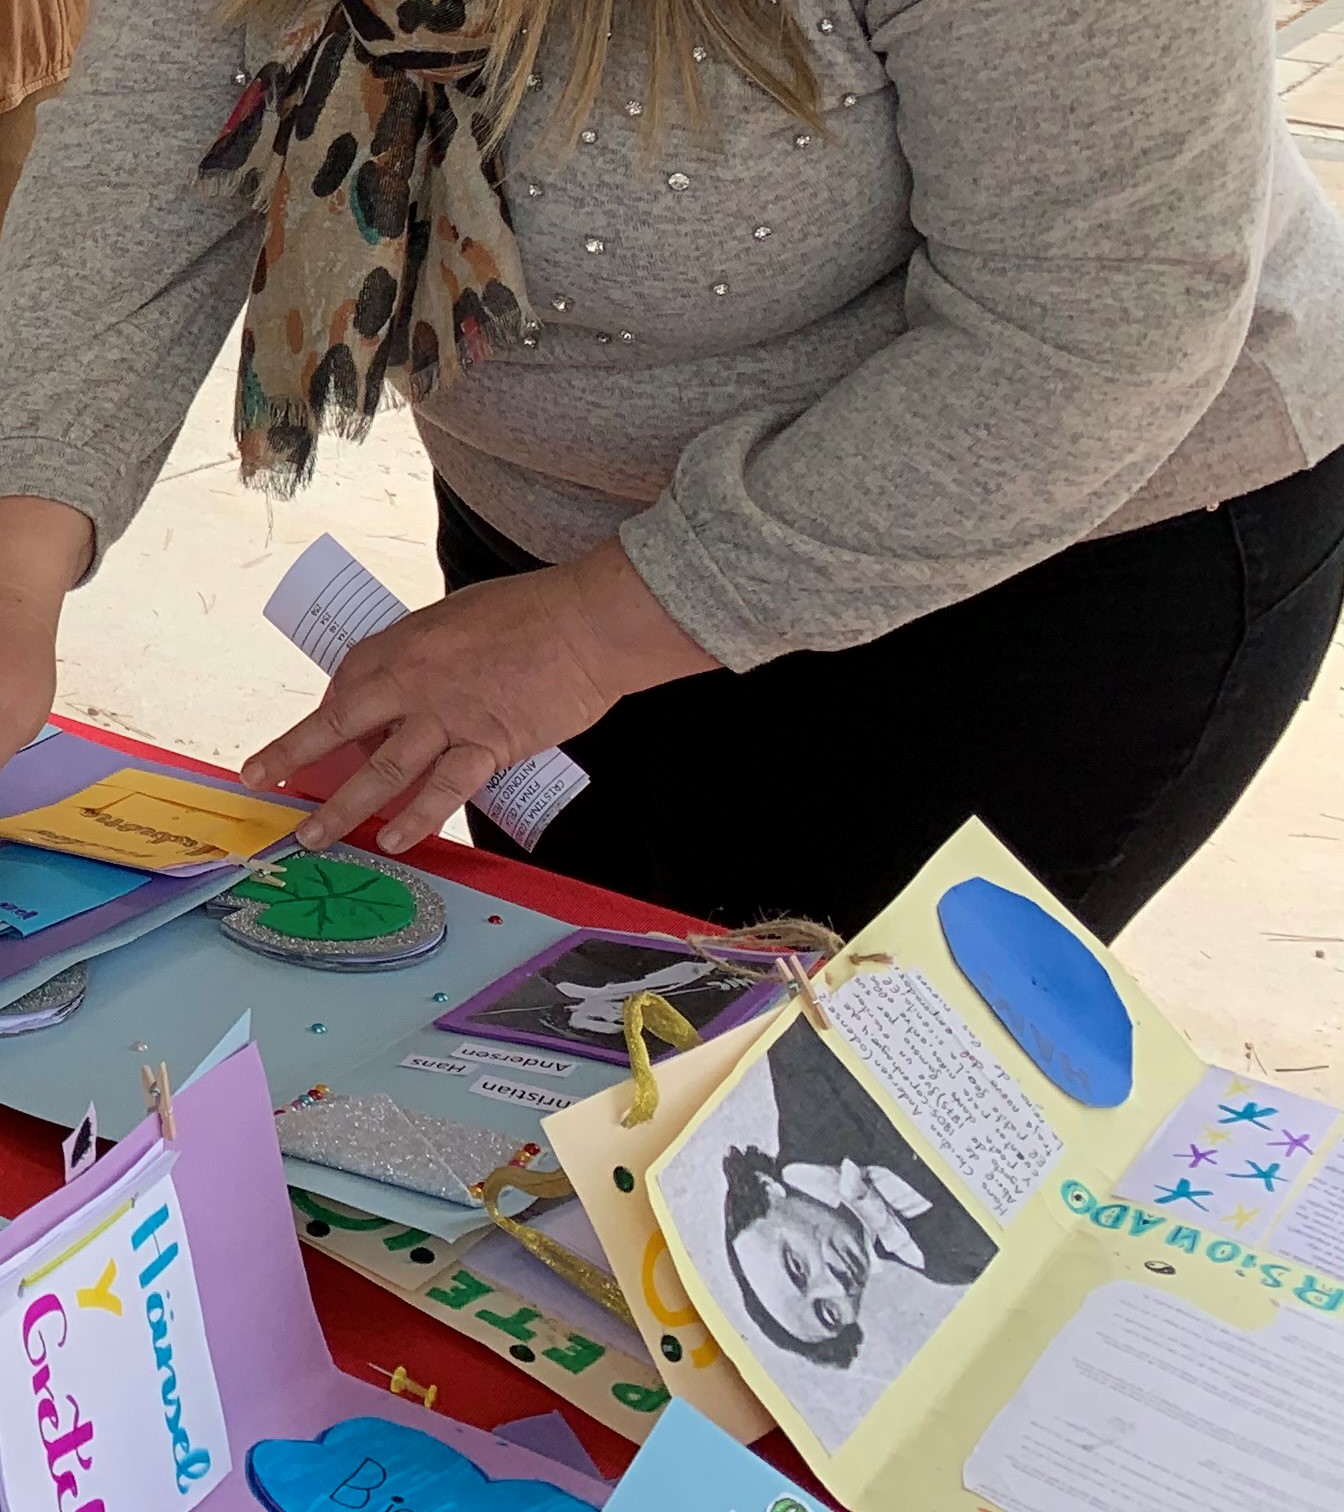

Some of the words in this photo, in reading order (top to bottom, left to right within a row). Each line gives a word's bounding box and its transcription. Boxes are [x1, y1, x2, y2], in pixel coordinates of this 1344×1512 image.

[500, 759, 538, 800] ANTONIO
[518, 780, 542, 805] FINA
[527, 779, 567, 821] CRISTINA
[842, 1001, 862, 1023] de
[876, 1002, 897, 1025] por
[412, 1056, 468, 1074] Hans
[460, 1045, 571, 1074] Andersen
[870, 1058, 923, 1118] Andersen
[963, 1145, 981, 1163] de
[984, 1170, 1018, 1207] Abril
[988, 1154, 1027, 1198] Agosto
[976, 1181, 1009, 1217] Hans
[75, 1257, 123, 1317] Y
